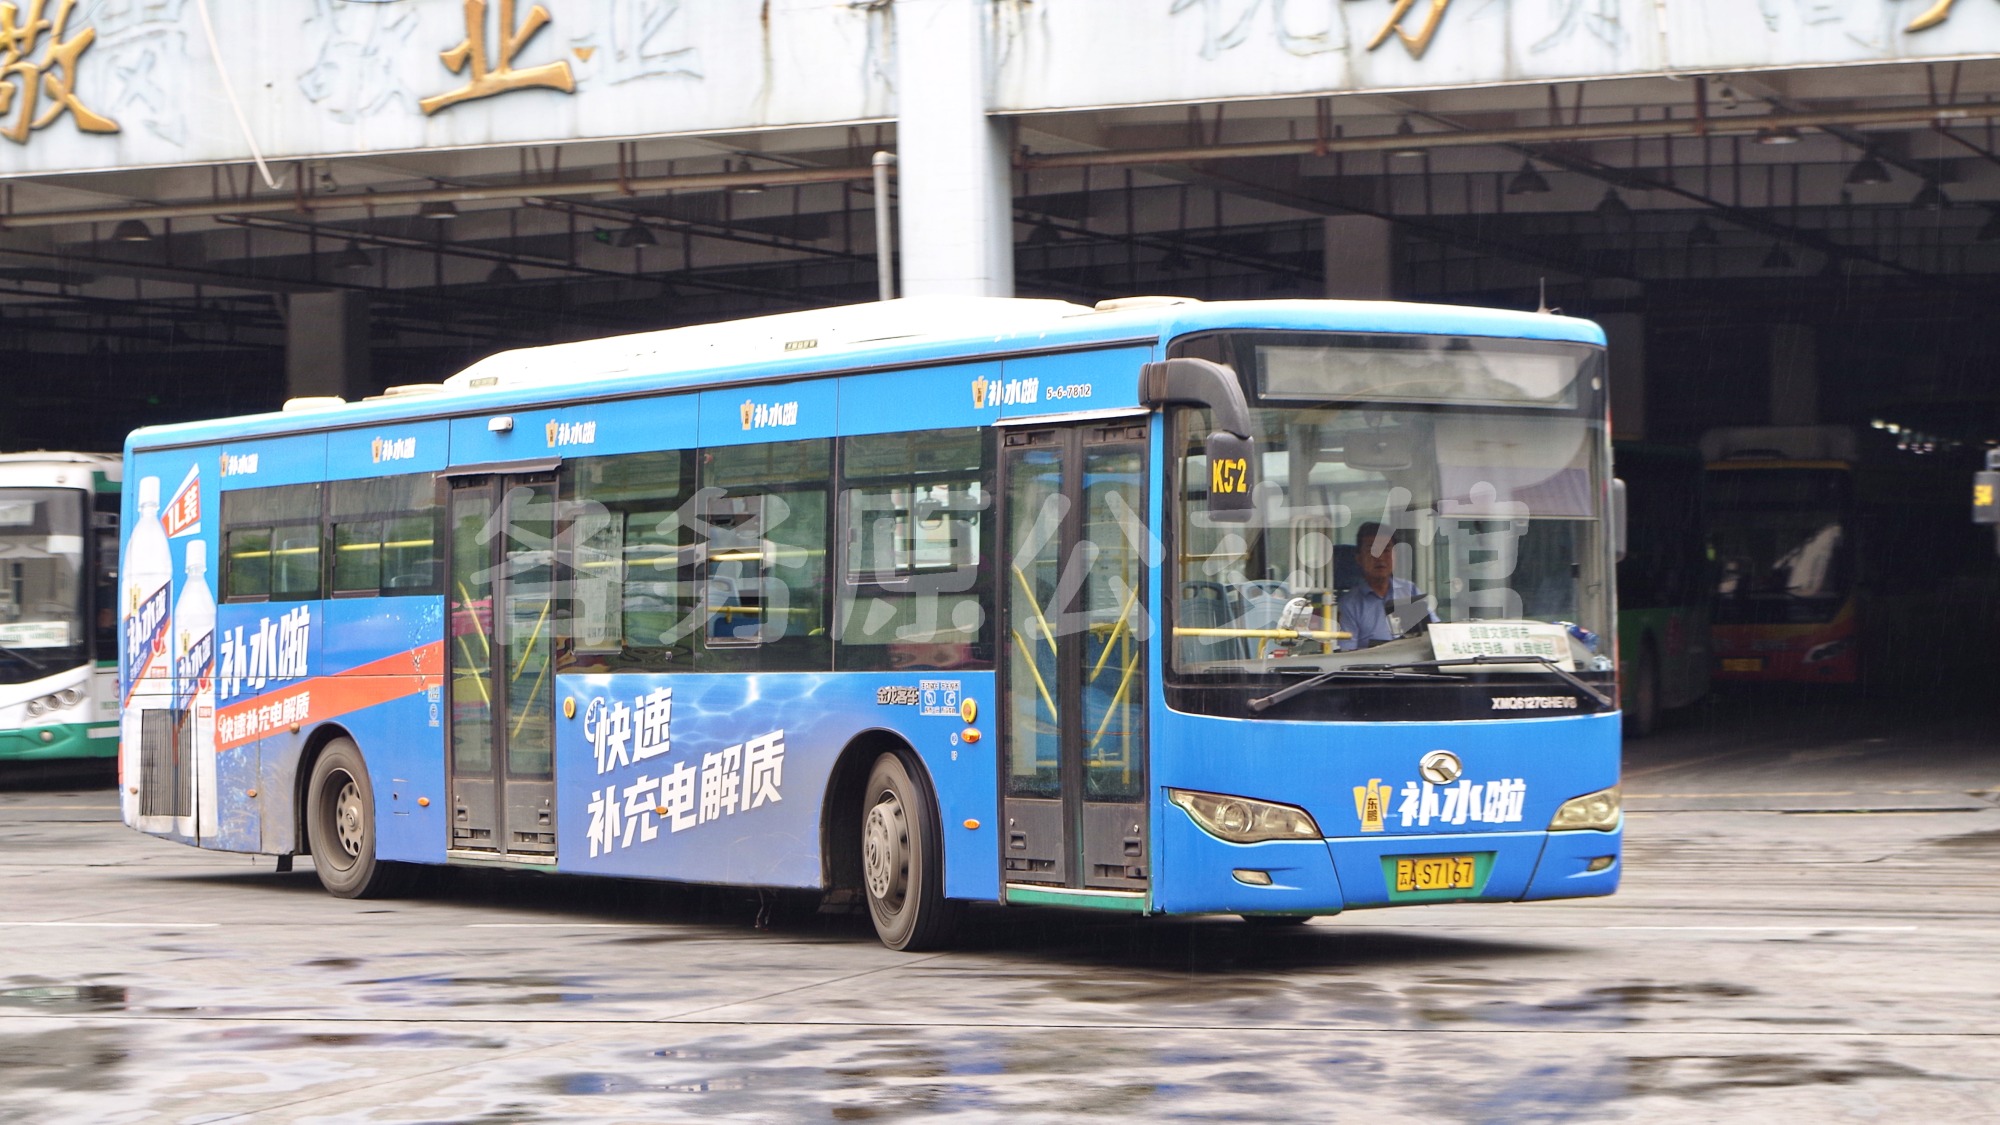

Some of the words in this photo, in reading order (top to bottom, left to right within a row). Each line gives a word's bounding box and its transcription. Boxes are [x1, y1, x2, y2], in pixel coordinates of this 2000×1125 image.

[988, 377, 1040, 407] 补水啦
[1046, 383, 1092, 401] 5-6-7812
[754, 401, 799, 428] 补水啦
[558, 421, 597, 446] 补水啦
[1212, 458, 1247, 493] K52
[220, 604, 311, 701] 补水啦
[876, 685, 920, 706] 金龙客车
[220, 690, 311, 745] 快速补充电解质
[594, 686, 673, 775] 快速
[586, 728, 785, 858] 补充电解质
[1398, 778, 1527, 828] 补水啦
